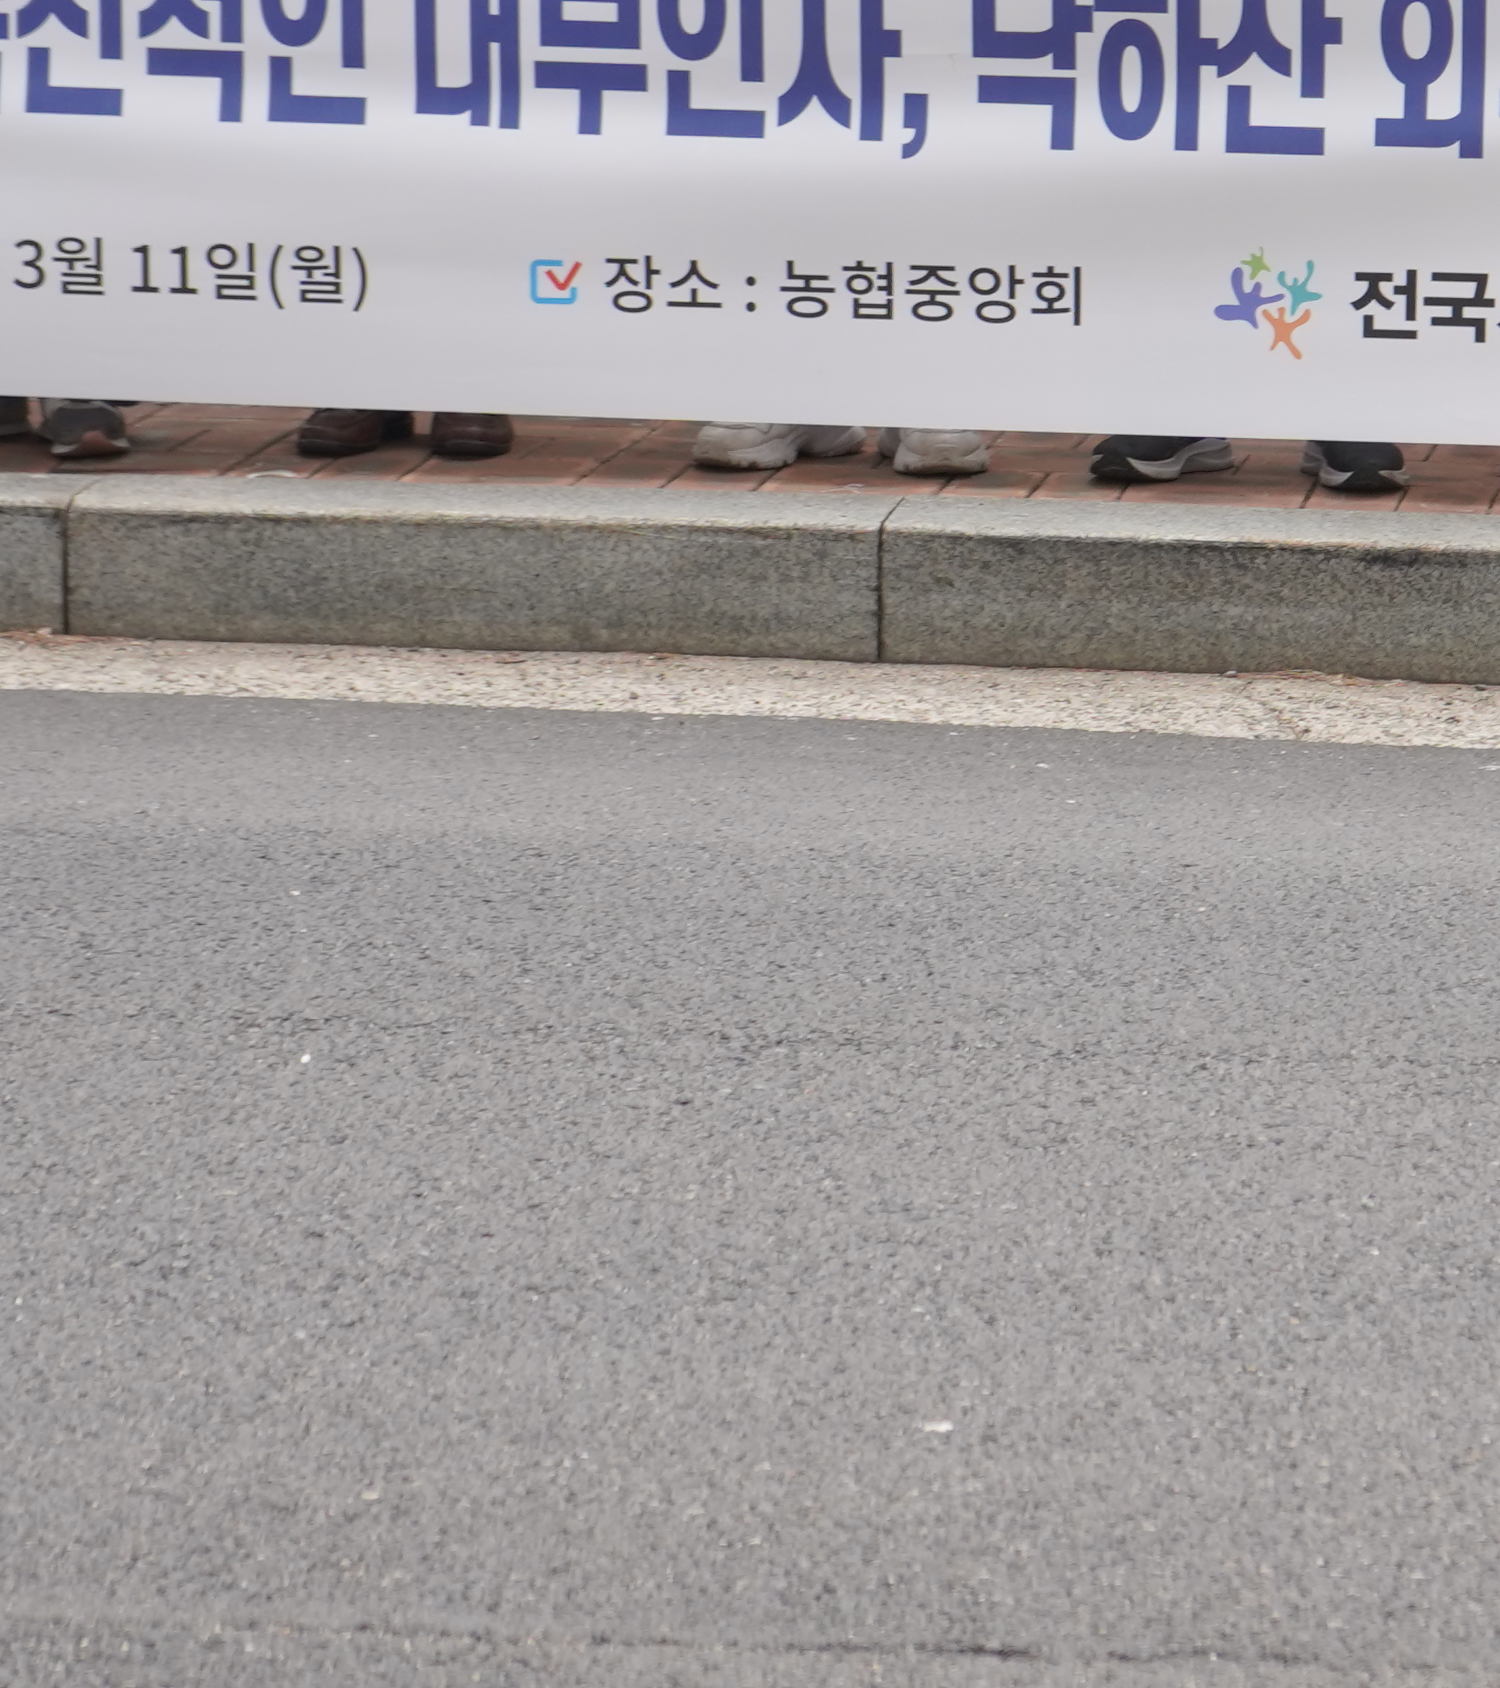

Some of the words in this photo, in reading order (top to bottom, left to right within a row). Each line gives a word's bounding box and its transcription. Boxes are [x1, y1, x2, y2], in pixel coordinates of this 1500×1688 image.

[13, 236, 106, 297] 3월
[131, 241, 368, 313] 11일(월)
[603, 254, 723, 315] 장소
[779, 258, 1083, 327] 농협중앙회
